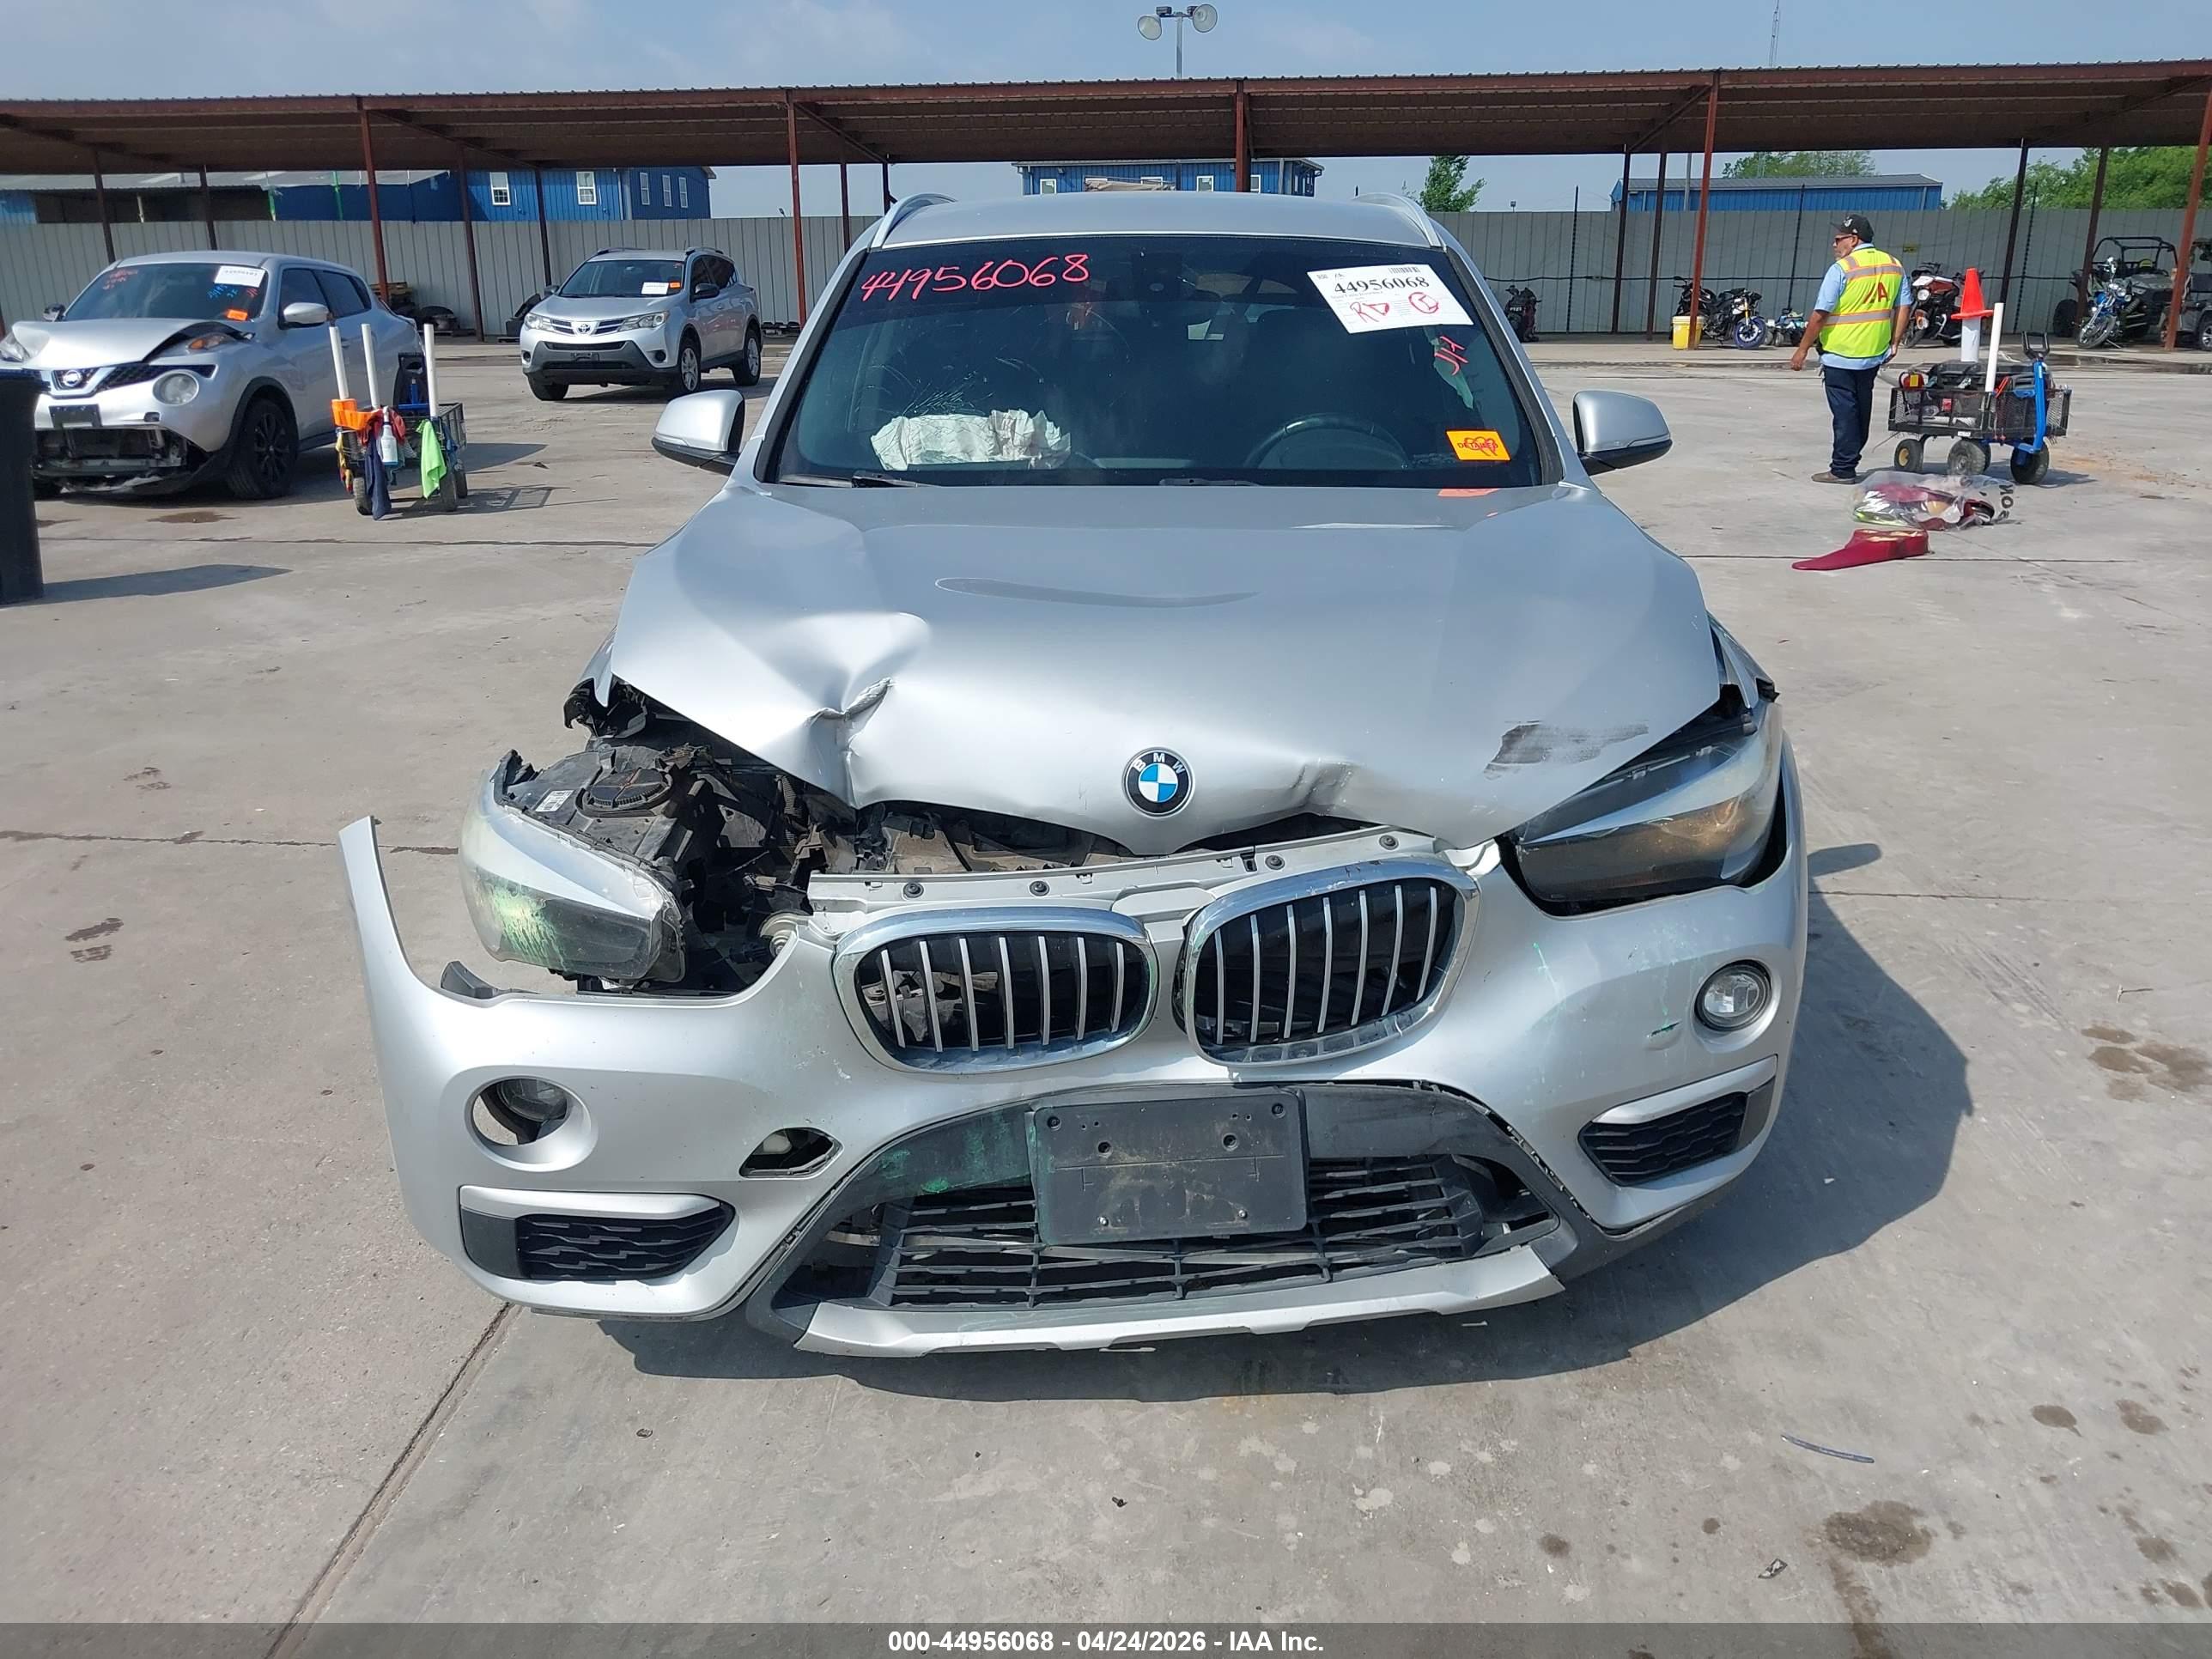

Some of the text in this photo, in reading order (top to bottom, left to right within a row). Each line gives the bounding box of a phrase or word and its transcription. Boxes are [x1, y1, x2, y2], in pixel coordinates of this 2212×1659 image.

[861, 253, 1090, 301] 44956068
[1334, 276, 1430, 293] 44956068
[1133, 752, 1186, 774] BMW
